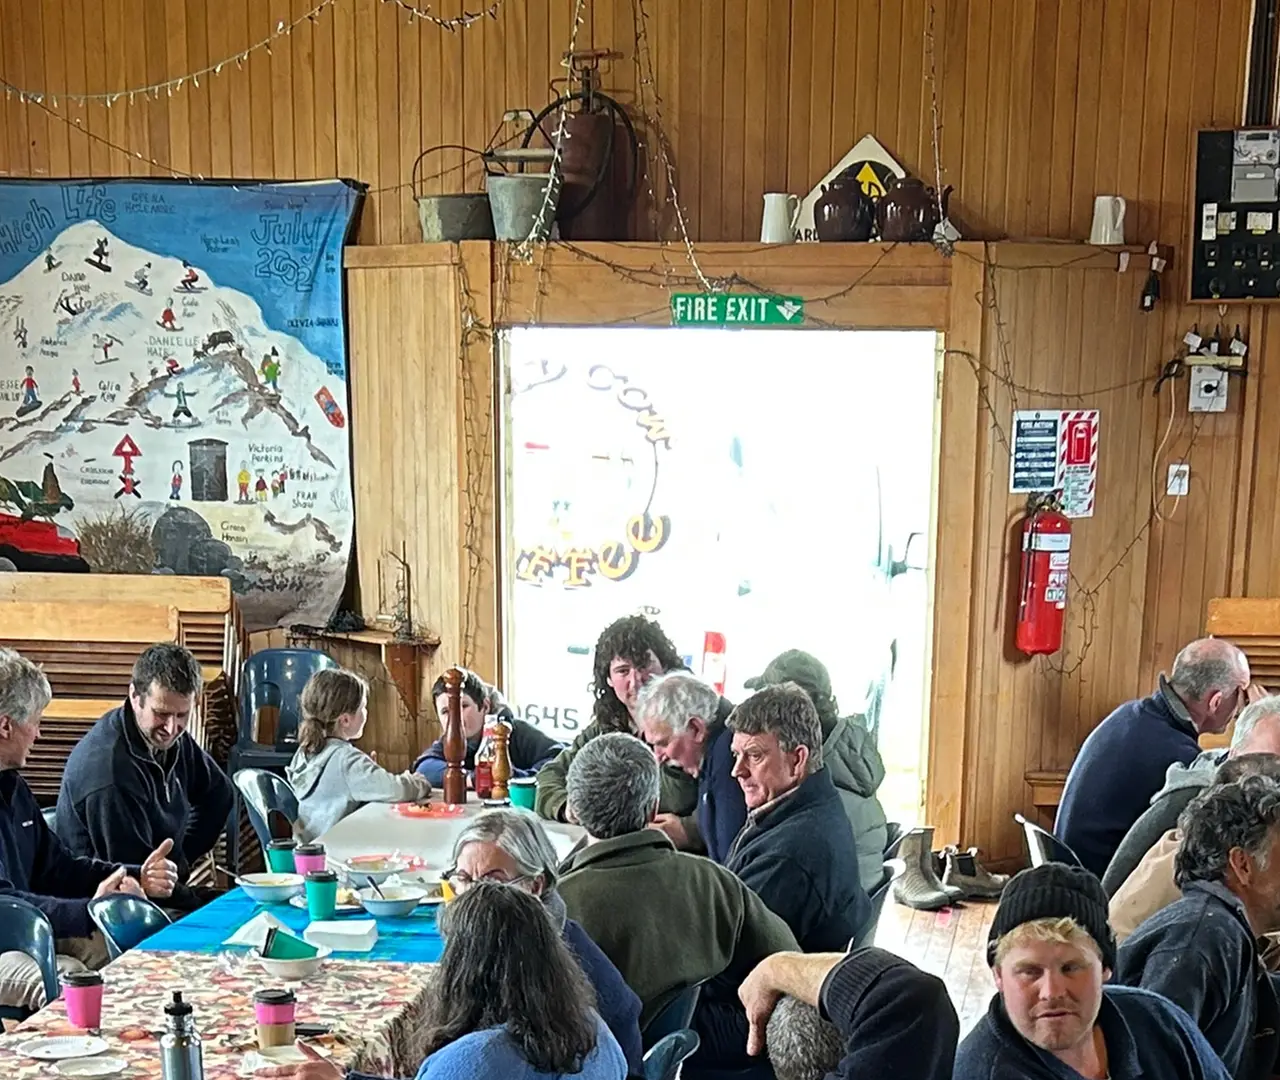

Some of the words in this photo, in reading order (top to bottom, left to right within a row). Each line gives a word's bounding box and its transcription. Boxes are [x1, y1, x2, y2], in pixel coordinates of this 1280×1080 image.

[59, 184, 117, 223] Life
[251, 211, 324, 265] July
[255, 247, 313, 292] 2002
[675, 297, 718, 321] FIRE
[726, 297, 770, 322] EXIT
[248, 443, 283, 453] Victoria
